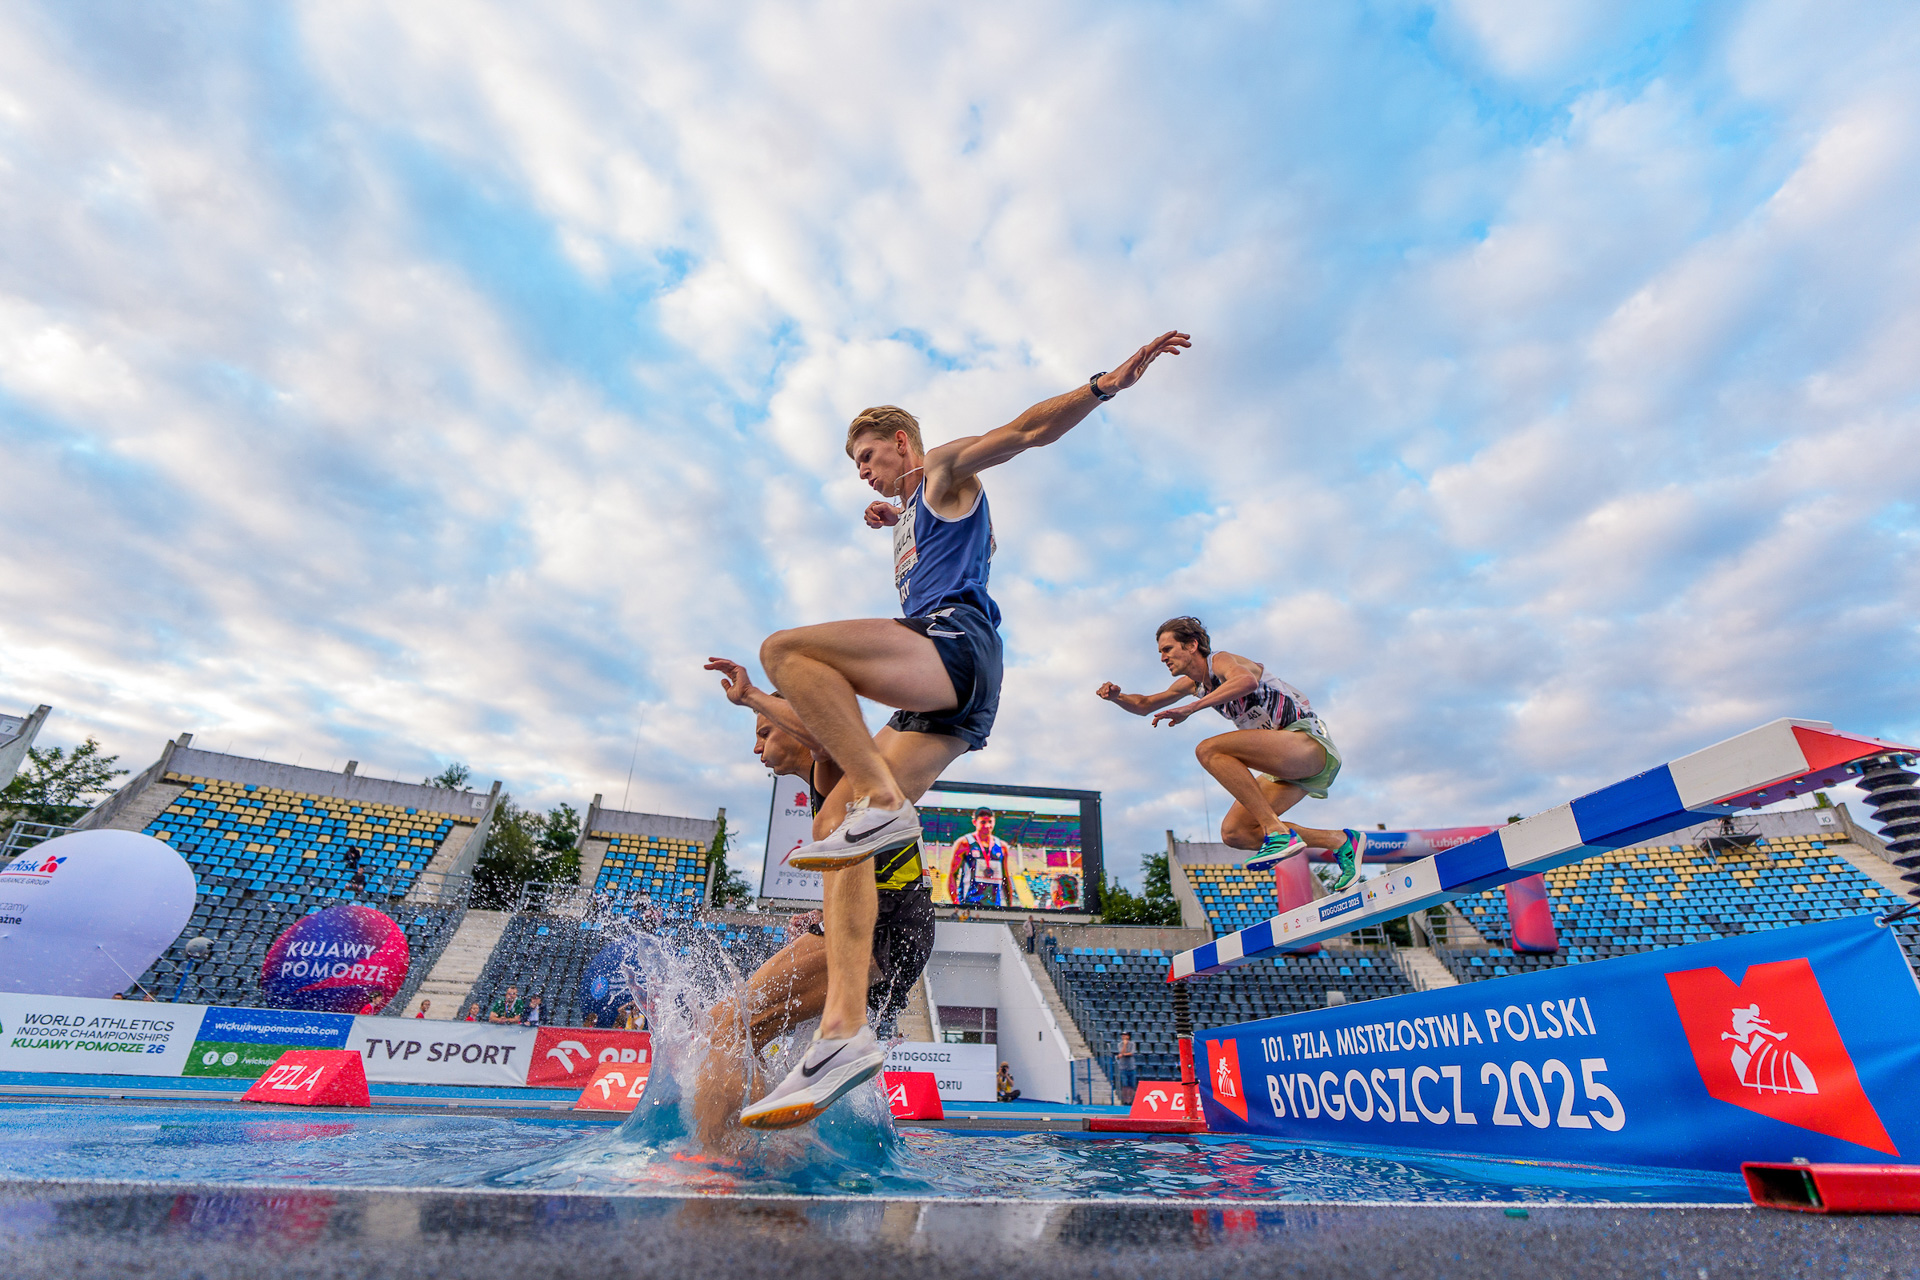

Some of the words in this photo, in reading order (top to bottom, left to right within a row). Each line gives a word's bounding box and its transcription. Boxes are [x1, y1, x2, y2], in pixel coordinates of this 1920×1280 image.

[1247, 709, 1261, 720] 461
[1321, 901, 1348, 917] BYDGOSZCZ
[1348, 897, 1360, 908] 2025
[286, 941, 376, 960] KUJAWY
[281, 961, 388, 982] POMORZE
[24, 1013, 85, 1027] WORLD
[88, 1017, 175, 1032] ATHLETICS
[215, 1022, 339, 1035] wickujawypomorze26.com
[1261, 1036, 1291, 1062] 101.
[1294, 1031, 1332, 1060] PZLA
[1337, 1012, 1483, 1056] MISTRZOSTWA
[1485, 997, 1597, 1042] POLSKI
[16, 1027, 67, 1037] INDOOR
[70, 1030, 169, 1042] CHAMPIONSHIPS
[11, 1038, 74, 1050] KUJAWY
[75, 1041, 145, 1053] POMORZE
[146, 1044, 165, 1054] 26
[366, 1038, 422, 1060] TVP
[427, 1042, 516, 1065] SPORT
[892, 1051, 951, 1062] BYDGOSZCZ
[260, 1065, 325, 1091] PZLA
[937, 1080, 962, 1090] ORTU
[1266, 1065, 1478, 1125] BYDGOSZCZ
[1480, 1057, 1626, 1132] 2025
